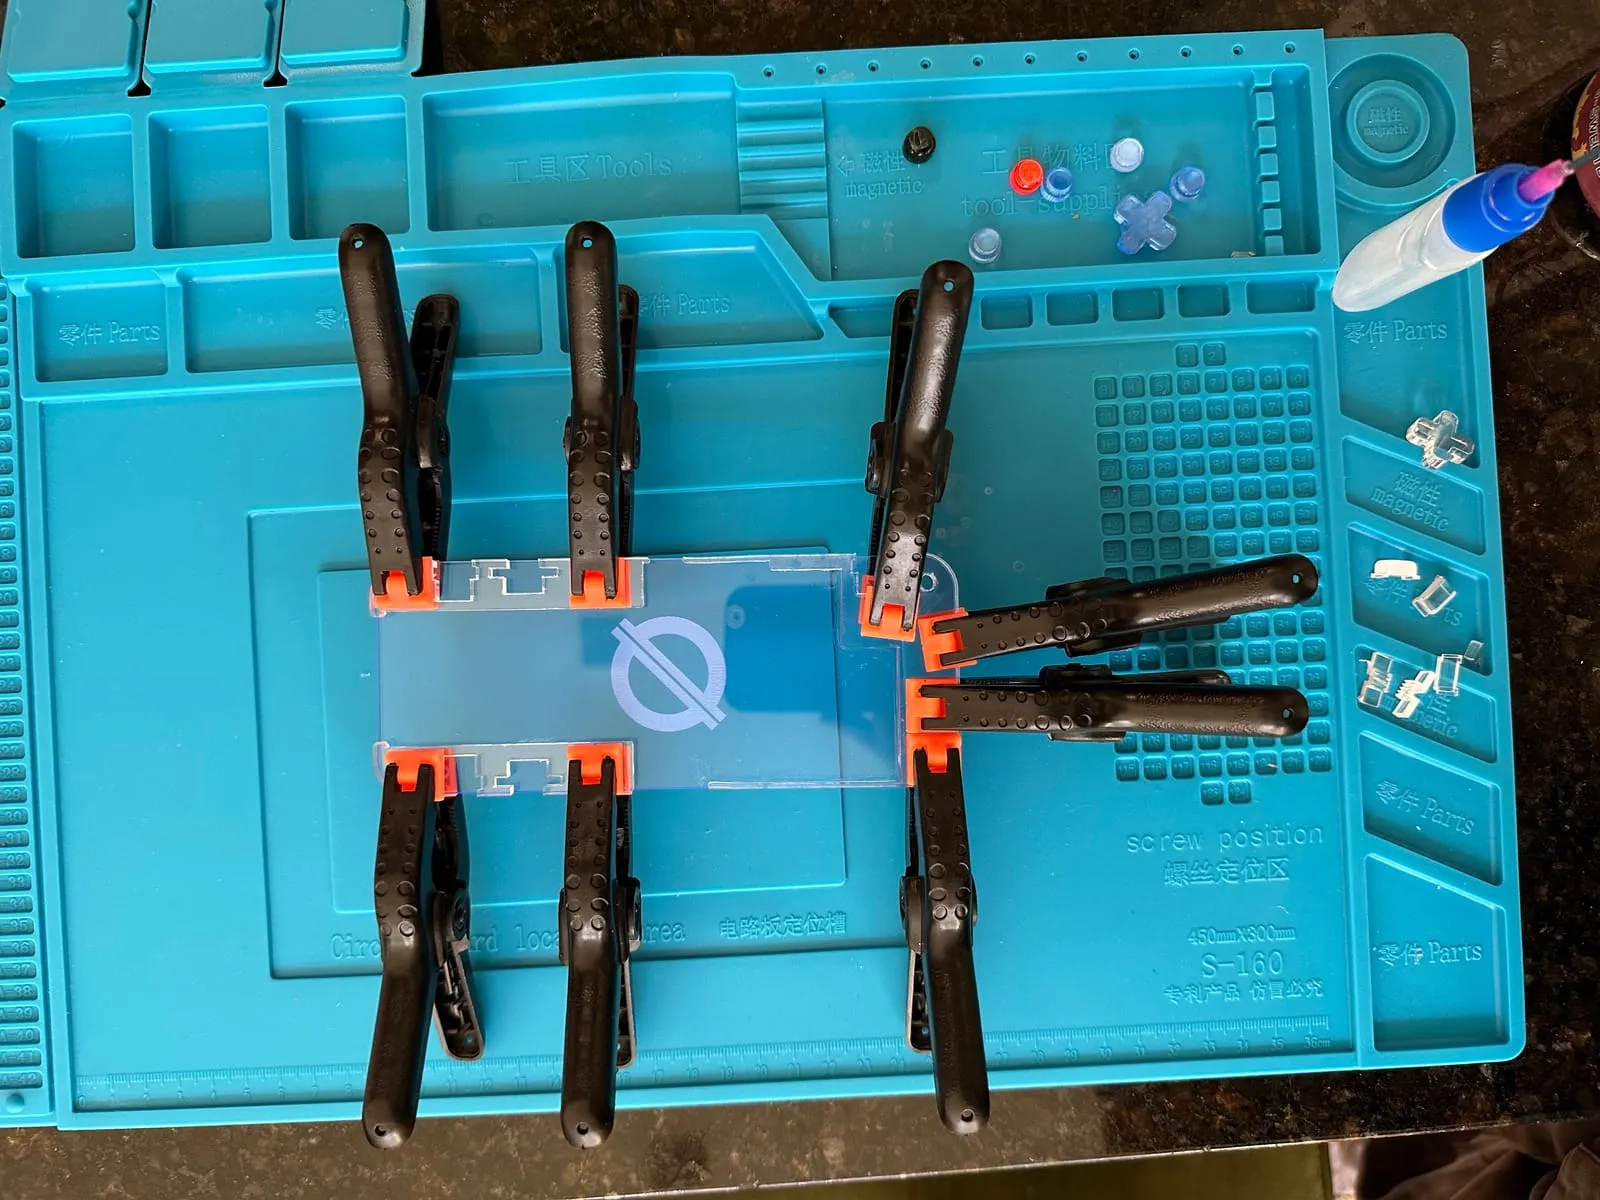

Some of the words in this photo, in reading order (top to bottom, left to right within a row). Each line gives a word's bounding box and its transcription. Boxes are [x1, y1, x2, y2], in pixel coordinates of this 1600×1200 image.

[845, 176, 923, 200] magnetic
[677, 293, 730, 315] Parts
[59, 324, 102, 346] 零件
[108, 321, 160, 343] Parts
[1343, 321, 1389, 344] 零件
[1393, 319, 1448, 341] Parts
[1370, 488, 1449, 532] magnetic
[1420, 796, 1475, 836] Parts
[1219, 822, 1324, 853] position
[1164, 857, 1290, 887] 螺丝定位区
[720, 911, 847, 939] 电路板定位槽
[1202, 951, 1283, 979] S-160
[1428, 941, 1483, 963] Parts
